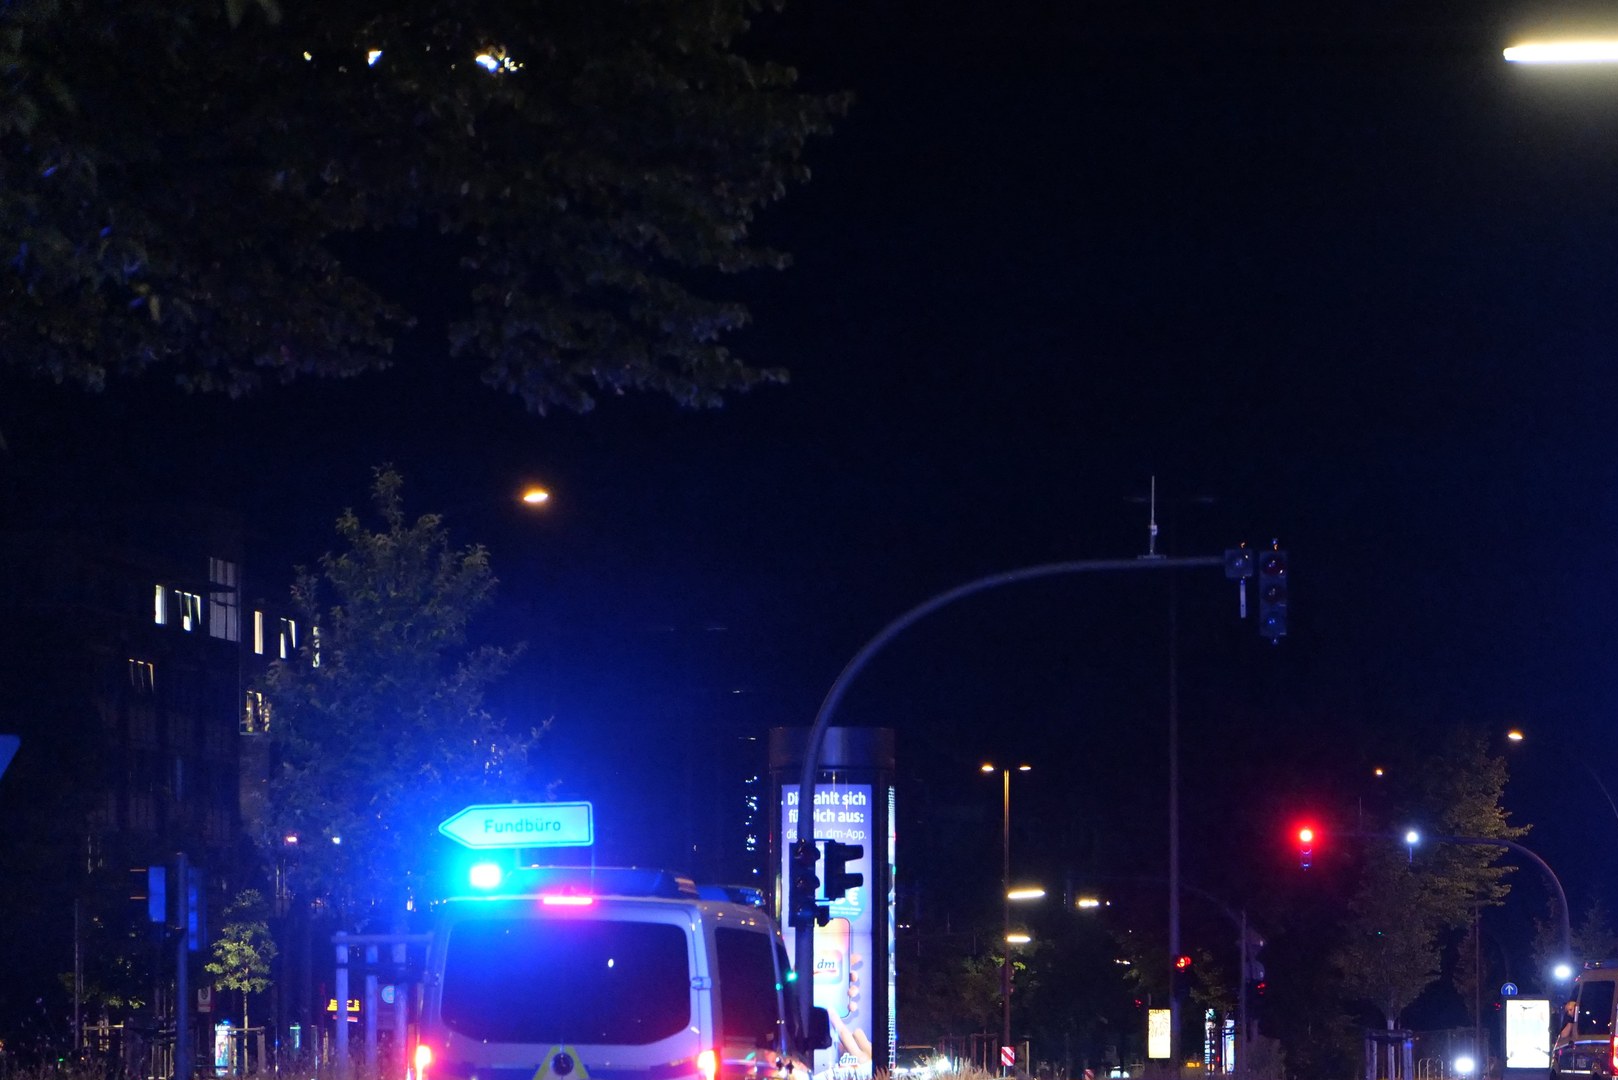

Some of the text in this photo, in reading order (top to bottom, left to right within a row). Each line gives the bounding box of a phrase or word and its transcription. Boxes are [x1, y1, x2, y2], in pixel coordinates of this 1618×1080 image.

[788, 791, 867, 806] Di ahlt sich
[788, 808, 799, 823] fü
[838, 811, 865, 823] aus:
[484, 818, 562, 833] Fundbüro
[826, 828, 867, 841] dm-App.
[817, 959, 835, 970] dm
[840, 1054, 858, 1065] dm
